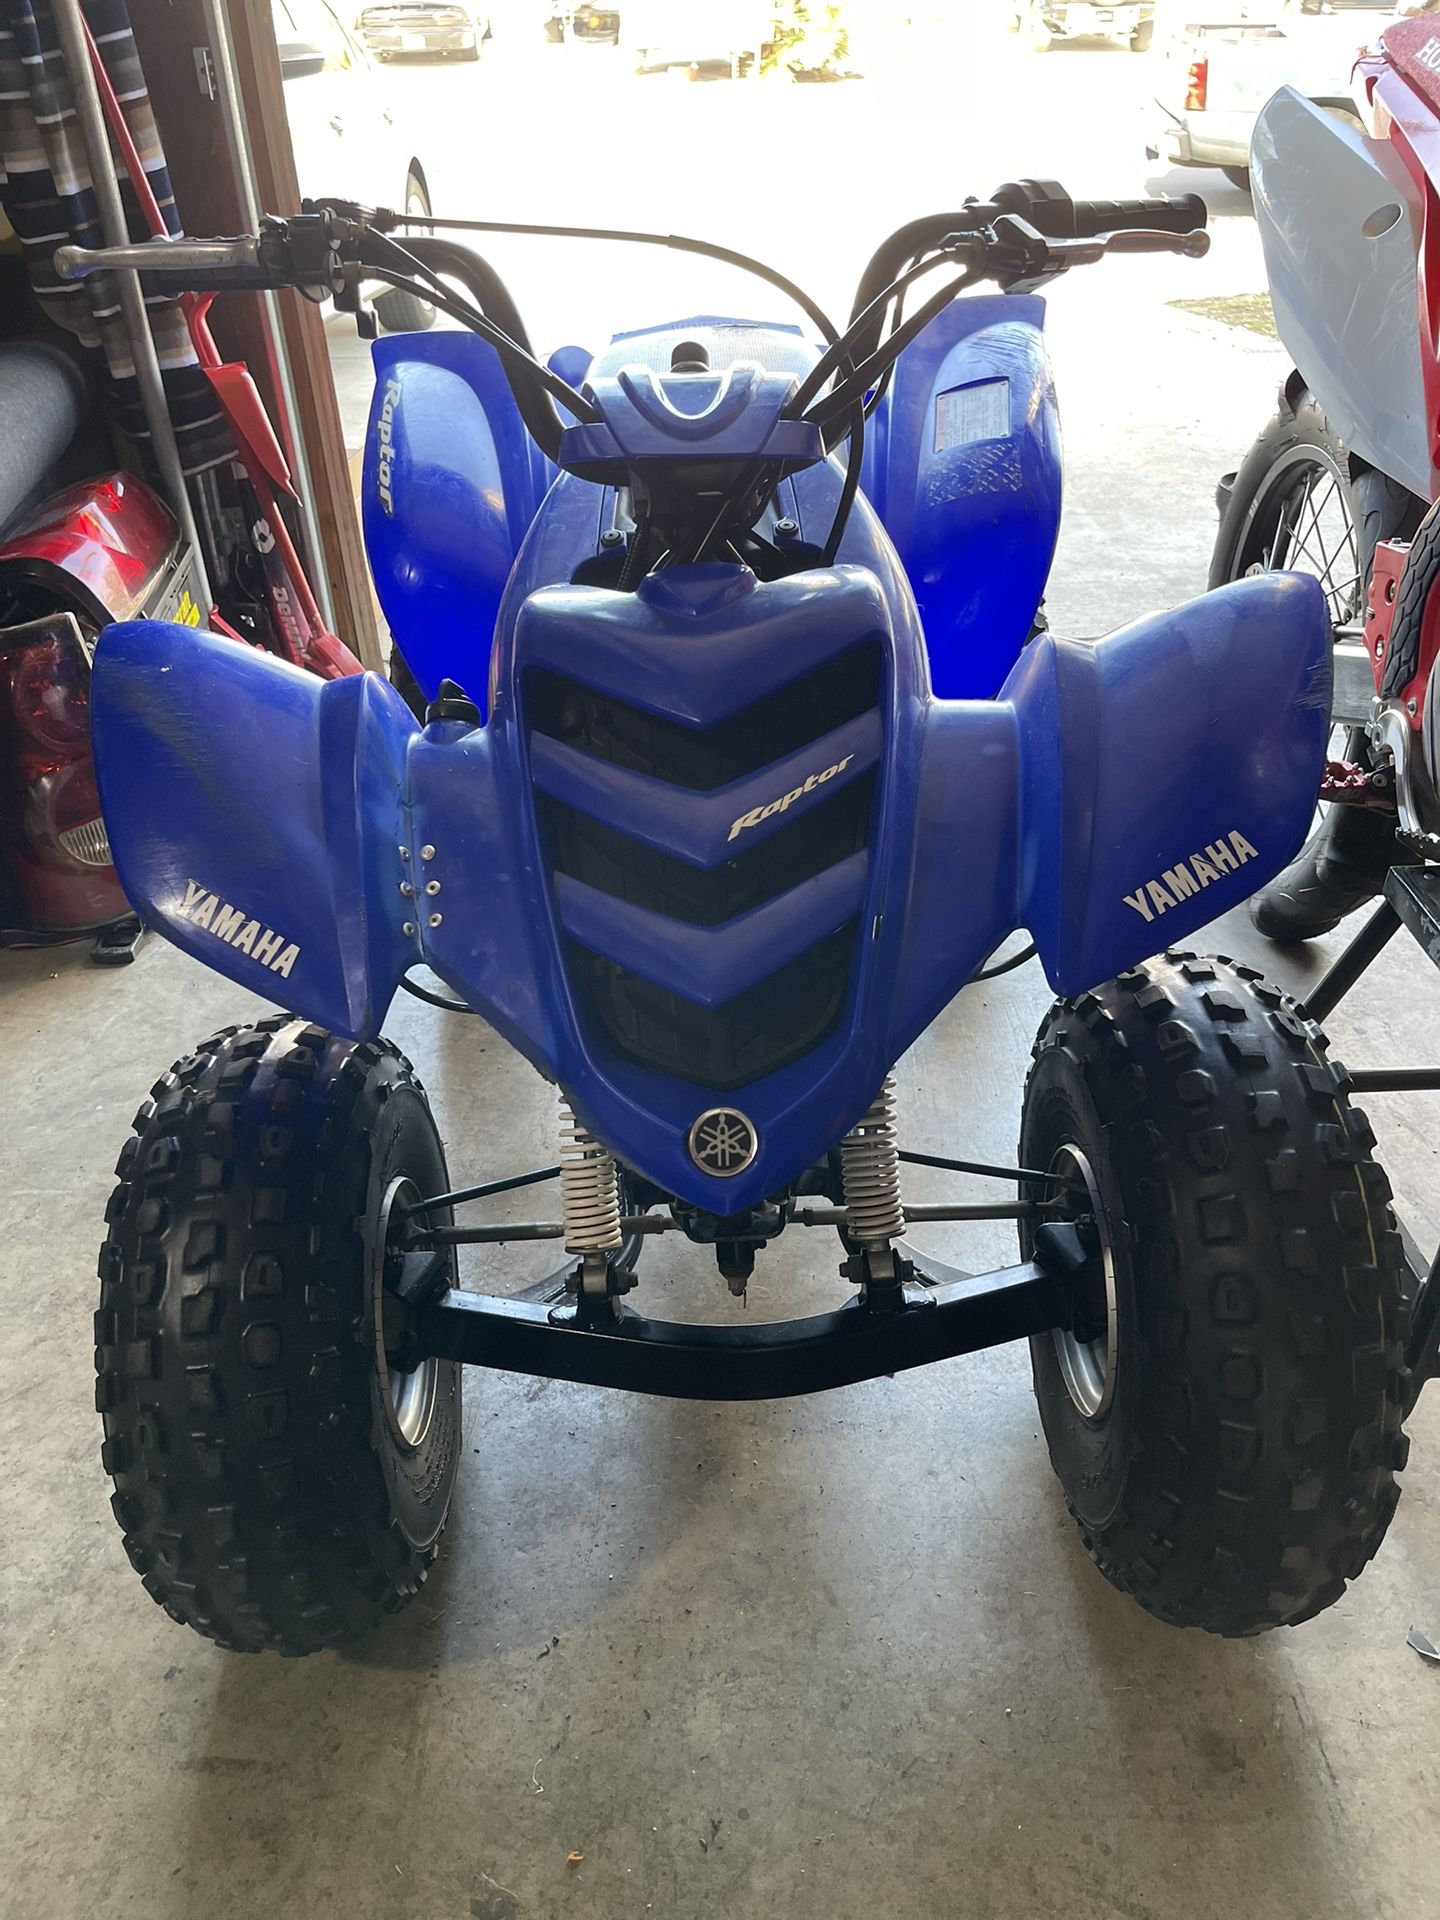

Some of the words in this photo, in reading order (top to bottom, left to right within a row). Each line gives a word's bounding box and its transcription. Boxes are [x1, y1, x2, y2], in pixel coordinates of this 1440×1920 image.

[377, 379, 402, 516] Raptor
[727, 753, 855, 842] Raptor
[1122, 829, 1259, 922] YAMAHA
[176, 880, 301, 979] YAMAHA
